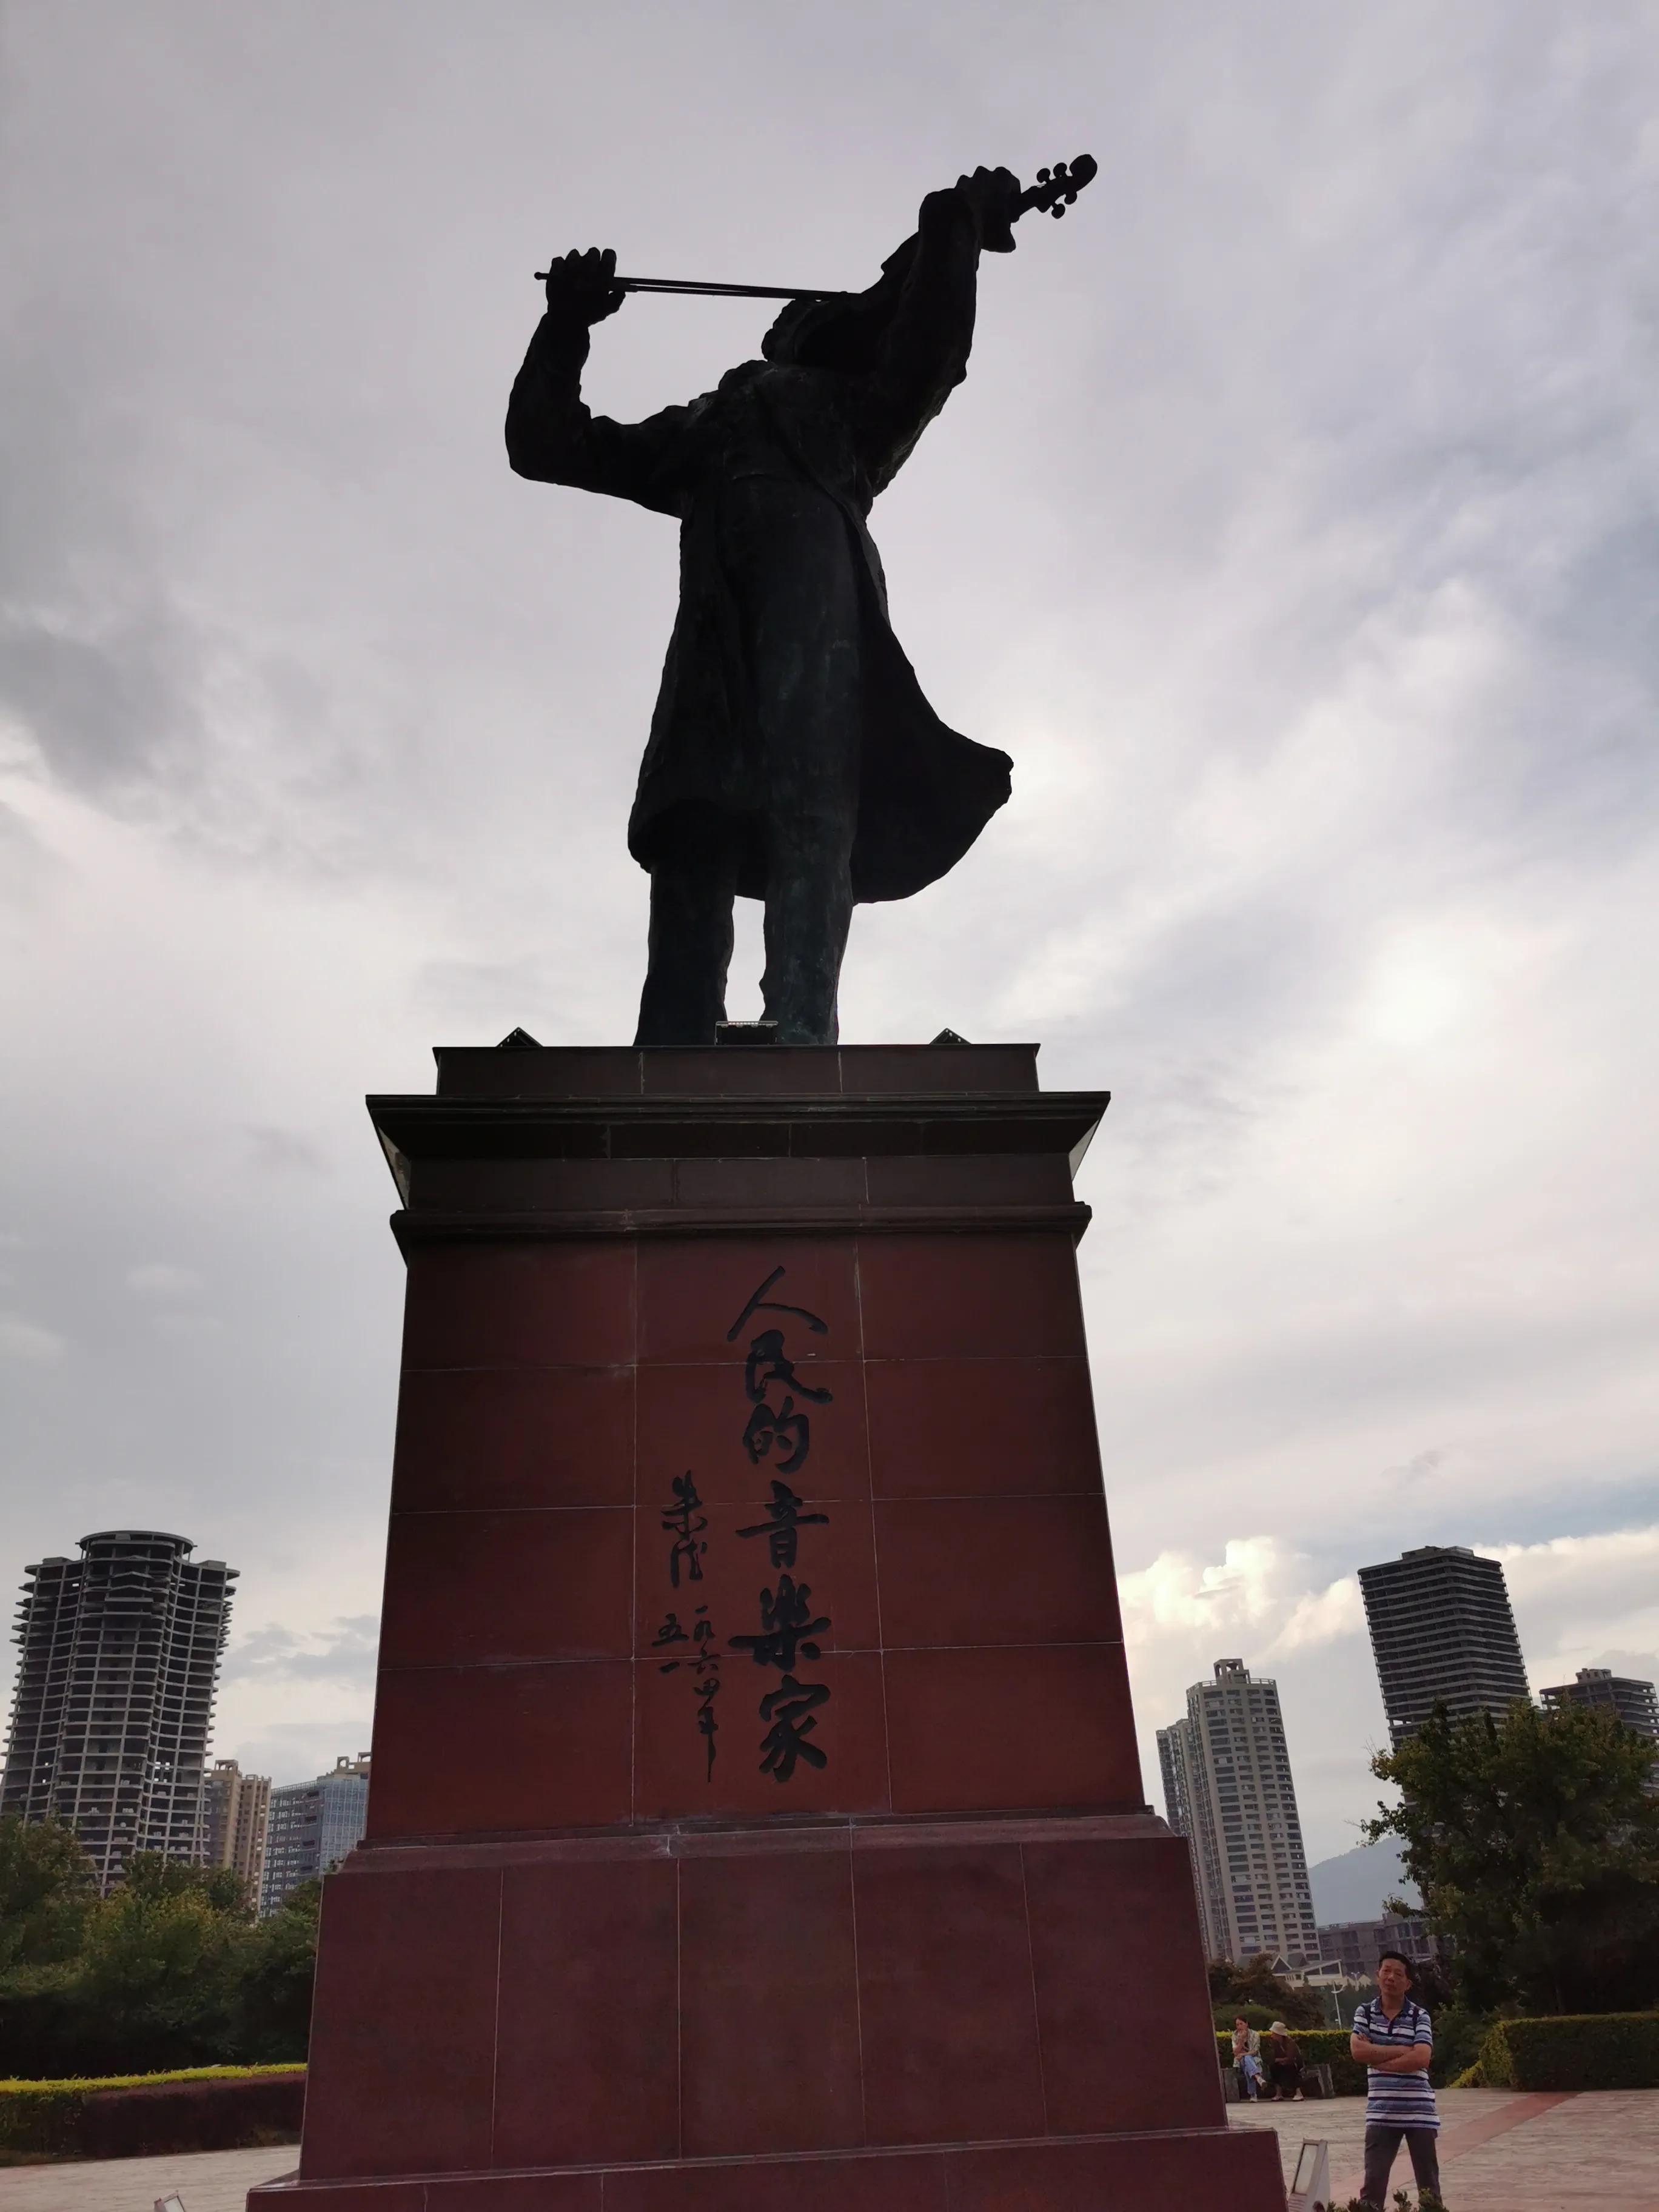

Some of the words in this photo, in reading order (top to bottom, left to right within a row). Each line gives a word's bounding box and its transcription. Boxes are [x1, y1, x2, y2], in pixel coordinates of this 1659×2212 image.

[728, 1266, 833, 1782] 人民的音樂家
